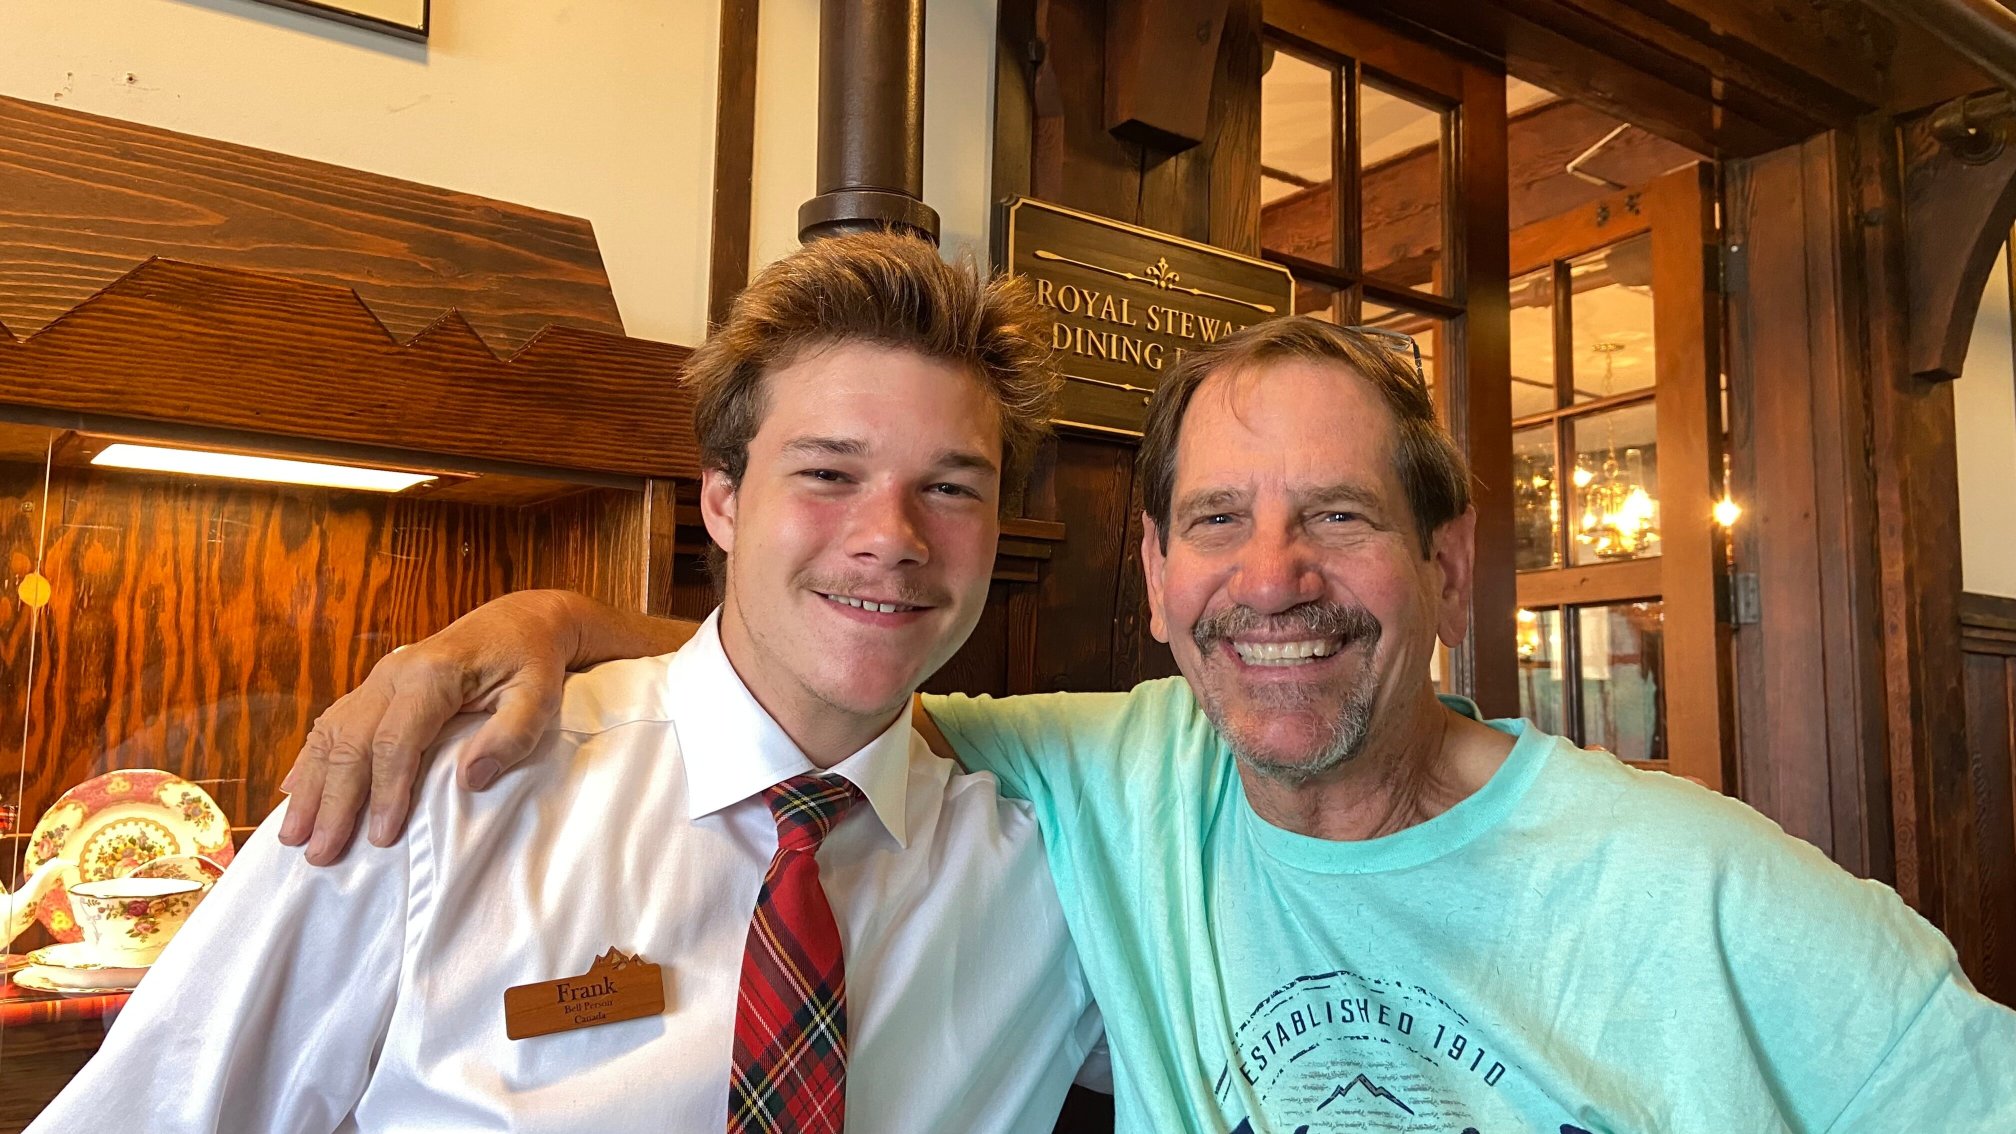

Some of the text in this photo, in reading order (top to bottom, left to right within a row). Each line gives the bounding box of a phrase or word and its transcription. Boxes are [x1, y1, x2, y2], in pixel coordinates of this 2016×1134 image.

[1036, 278, 1248, 344] ROYAL STEWA
[1051, 321, 1164, 370] DINING
[556, 976, 618, 1003] Frank
[564, 1000, 614, 1014] Bell Person
[574, 1012, 606, 1024] Canada
[1240, 998, 1506, 1087] ESTABLISHED 1910
